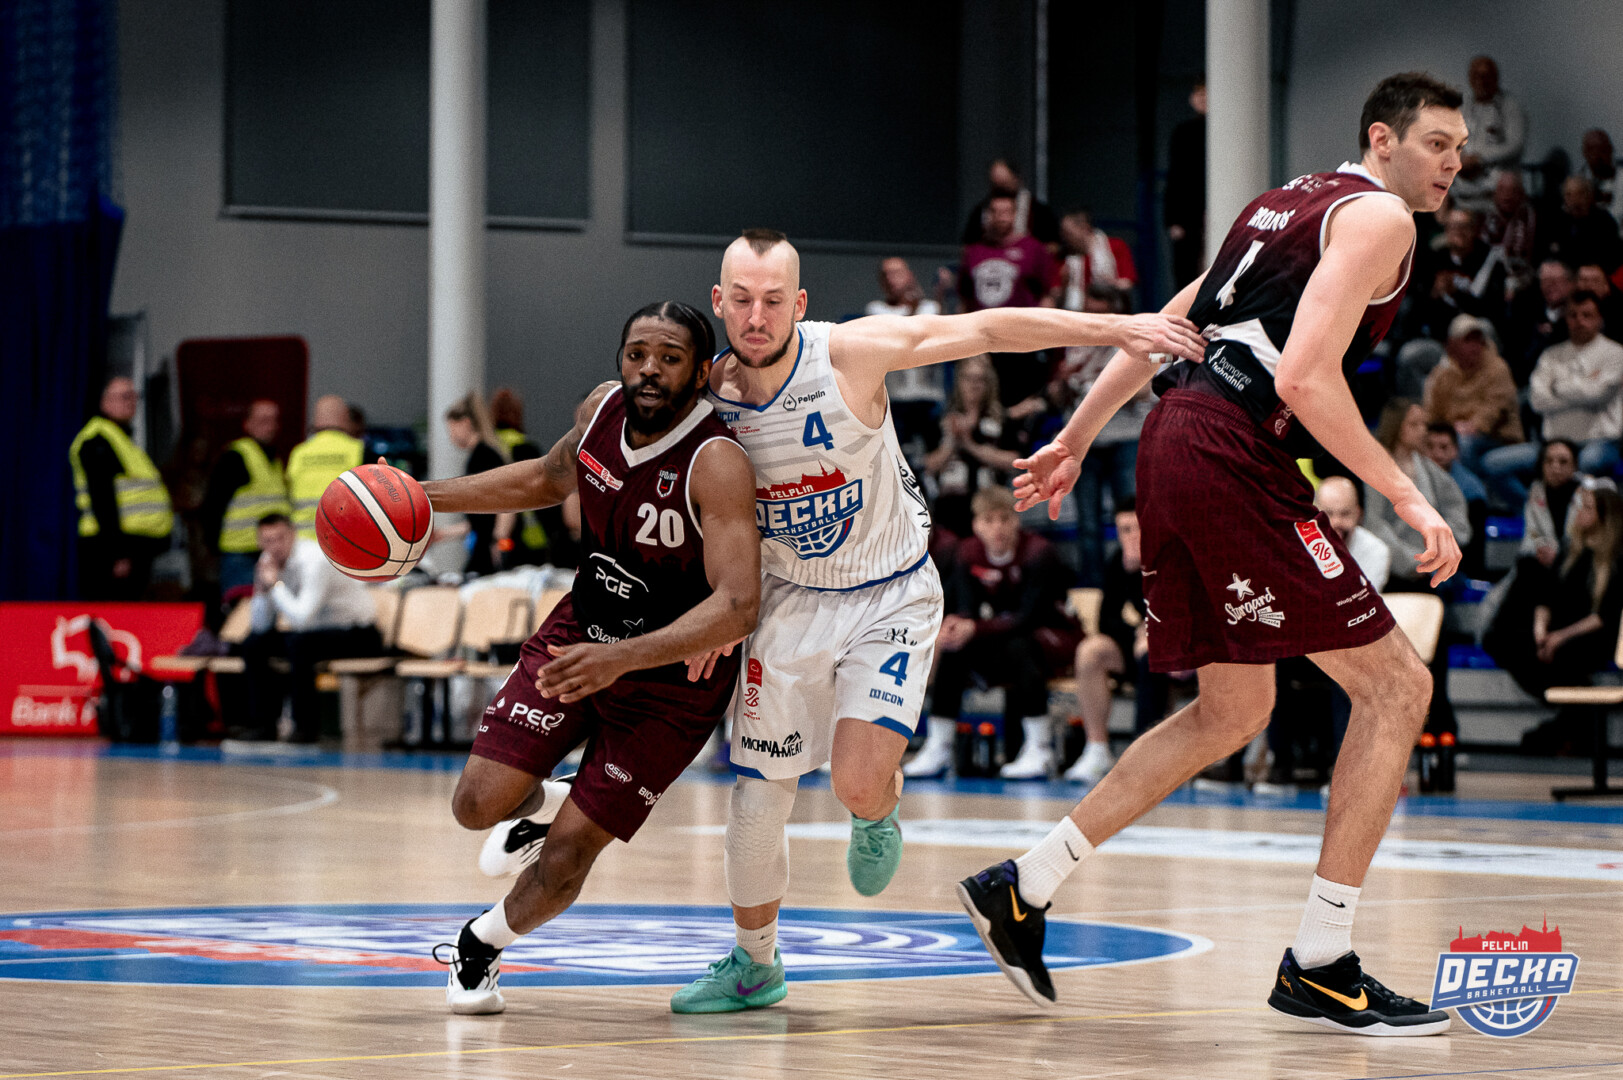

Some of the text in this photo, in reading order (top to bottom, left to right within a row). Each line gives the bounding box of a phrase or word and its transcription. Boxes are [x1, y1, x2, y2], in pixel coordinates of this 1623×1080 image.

[1219, 356, 1252, 386] Pomorze
[797, 389, 826, 404] Pelplin
[802, 410, 835, 451] 4
[755, 482, 860, 530] DECKA
[769, 484, 815, 499] PELPLIN
[635, 502, 685, 549] 20
[595, 565, 633, 599] PGE
[1347, 606, 1377, 628] COLO
[879, 651, 911, 687] 4
[881, 691, 905, 707] ICON
